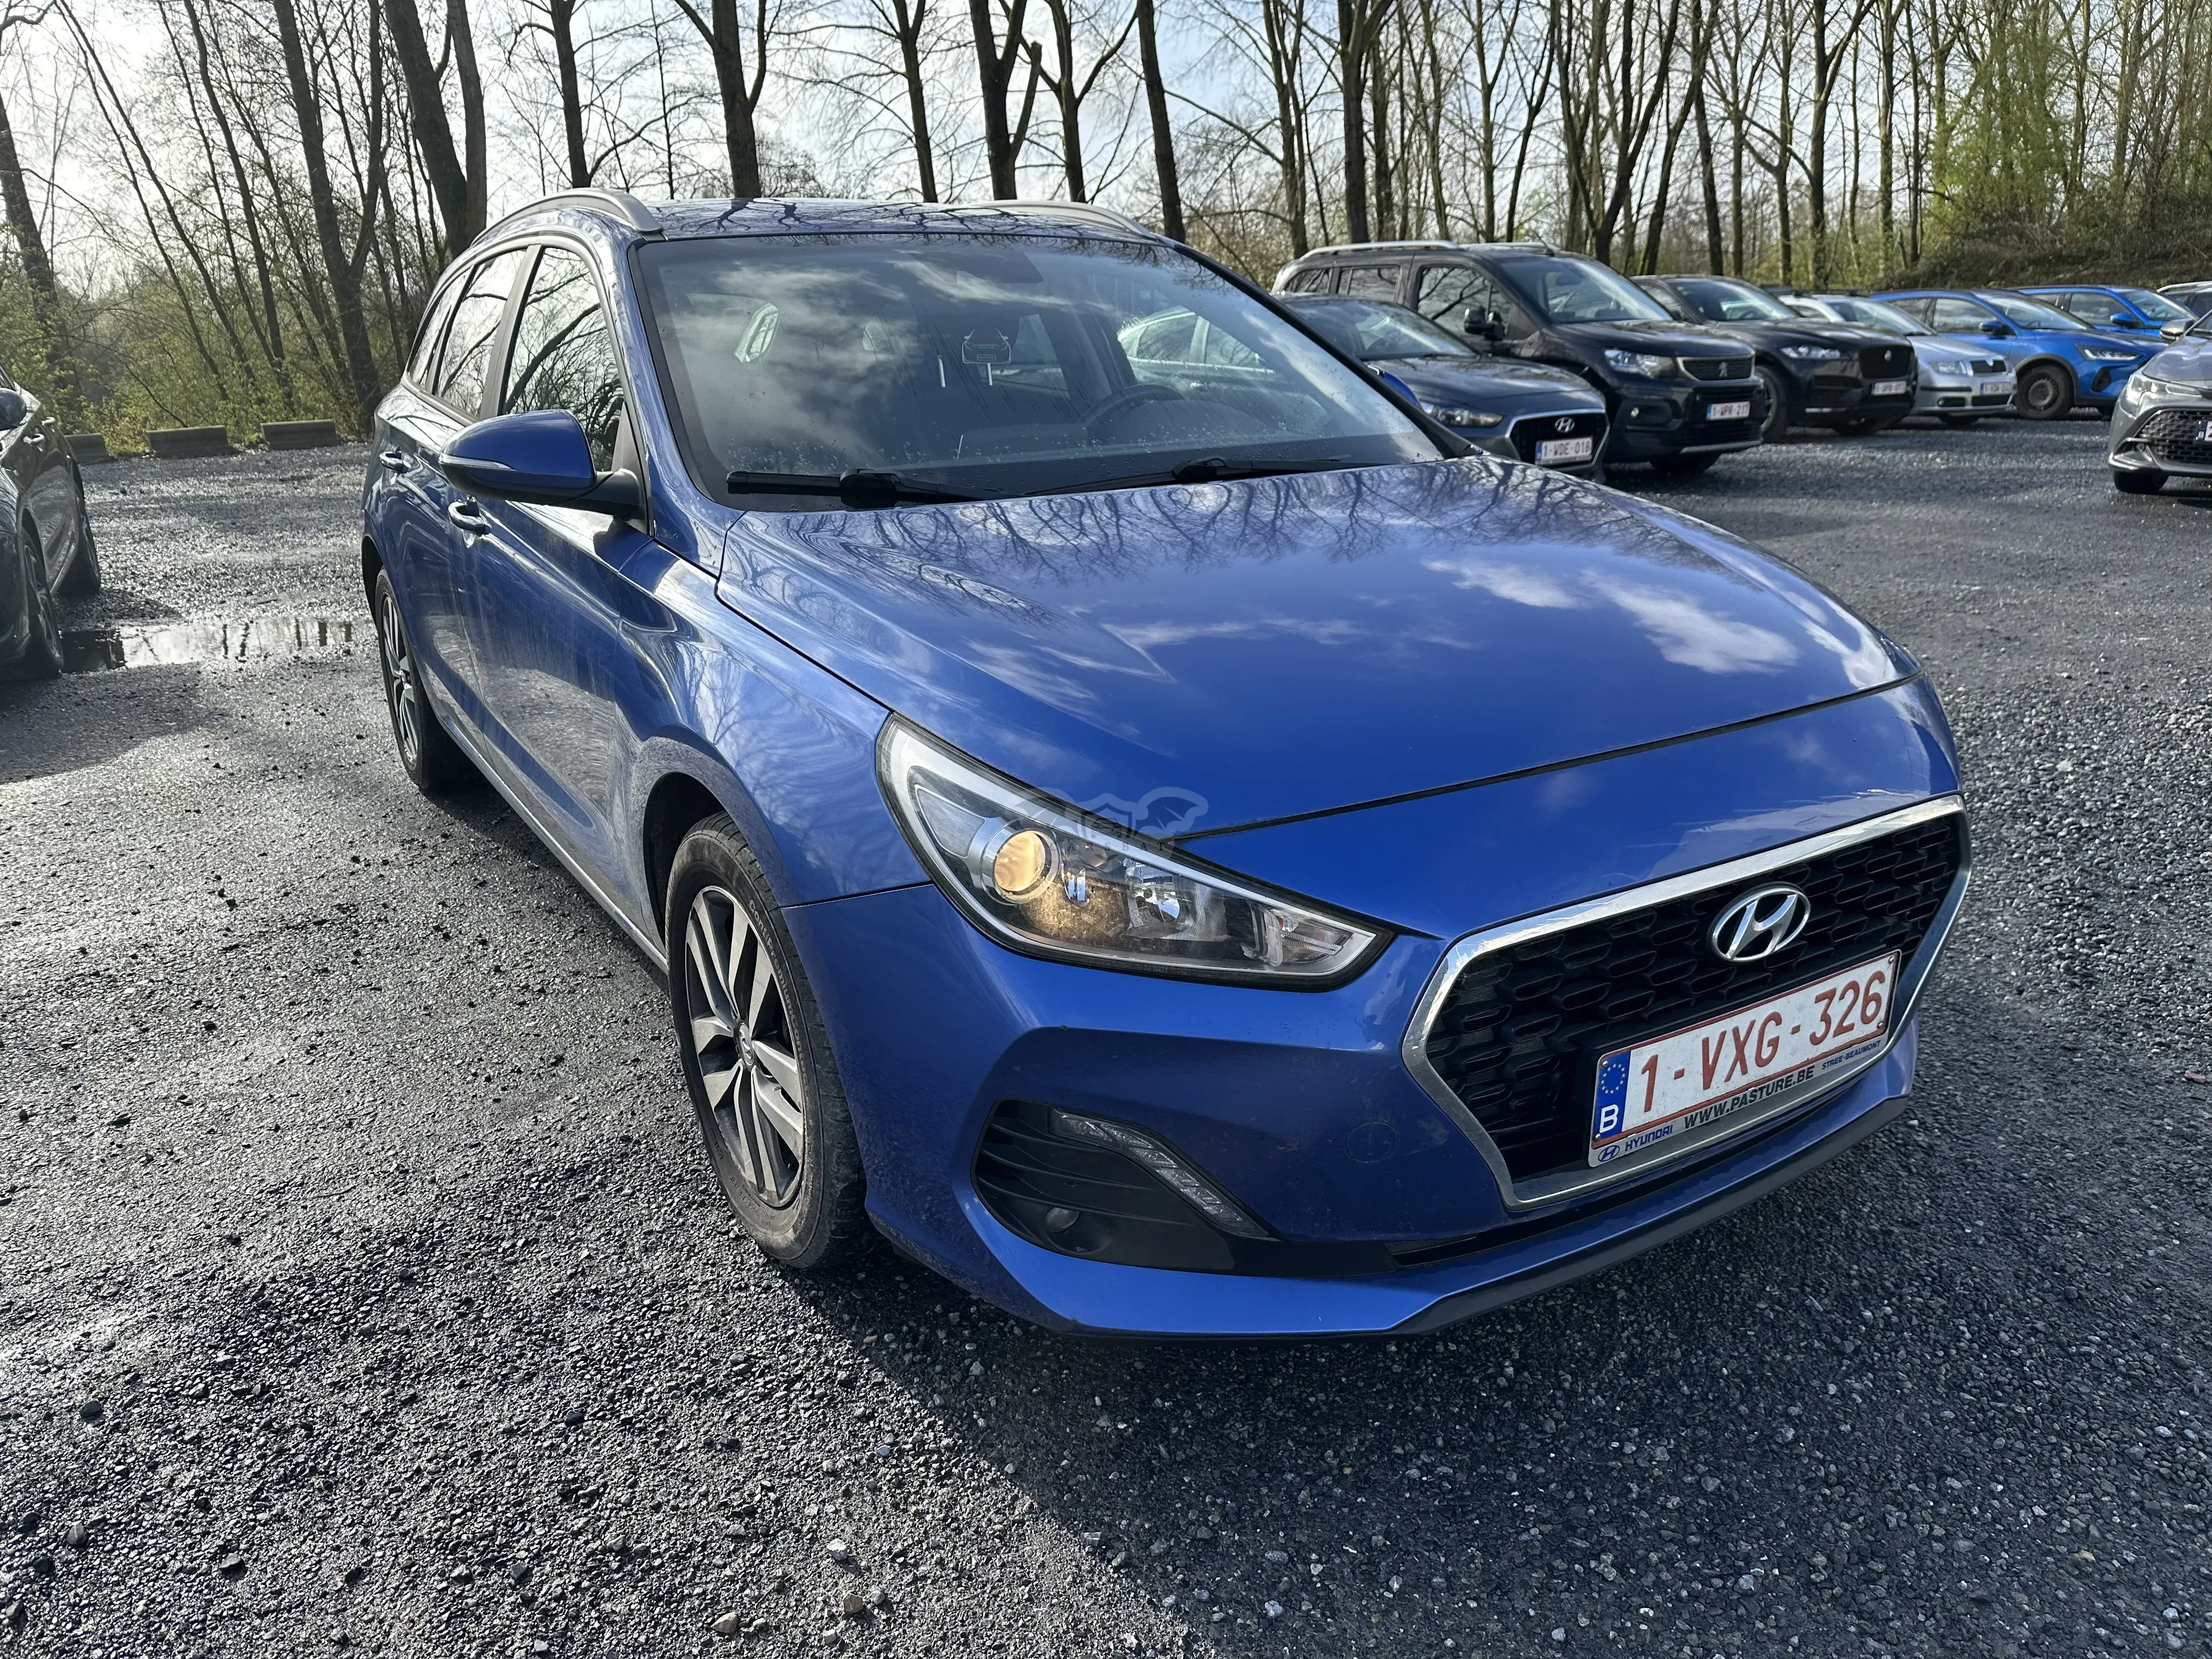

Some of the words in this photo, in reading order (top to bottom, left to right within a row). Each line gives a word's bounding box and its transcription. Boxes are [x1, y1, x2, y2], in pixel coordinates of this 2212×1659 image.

[1625, 1124, 1673, 1152] HYUNDAI
[1684, 1065, 1814, 1129] WWW.PASTURE.BE
[1821, 1040, 1881, 1070] STREE-BEAUMONT
[1641, 970, 1886, 1113] 1-VXG-326
[1599, 1104, 1619, 1133] B
